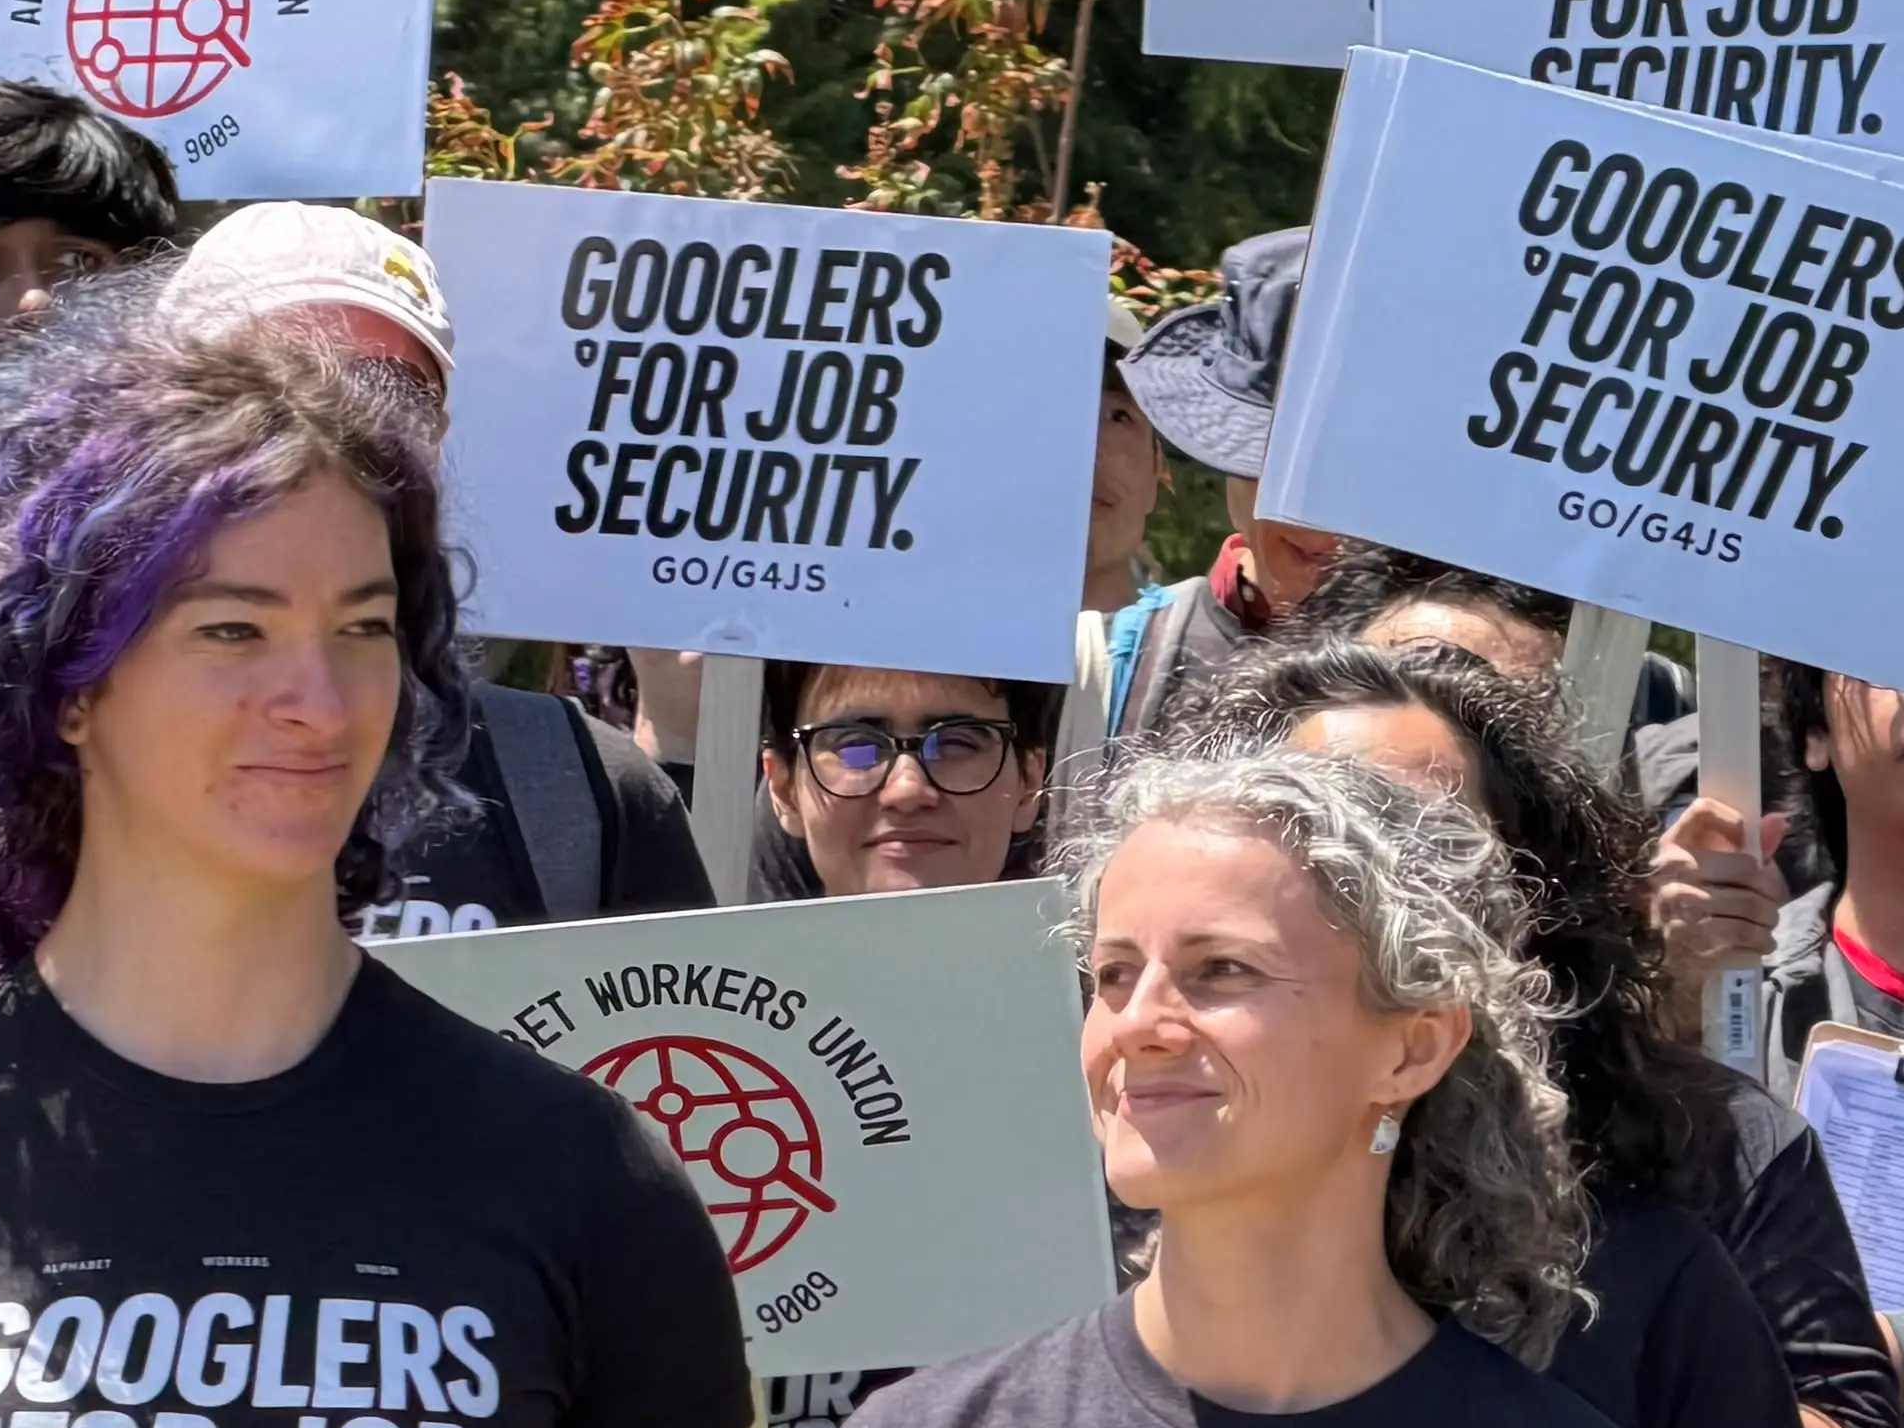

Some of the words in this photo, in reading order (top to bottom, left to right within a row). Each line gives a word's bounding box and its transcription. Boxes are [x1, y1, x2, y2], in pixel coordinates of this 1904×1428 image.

[183, 113, 242, 166] 9009
[561, 235, 951, 348] GOOGLERS
[1521, 255, 1694, 379] FOR
[1688, 301, 1870, 423] JOB
[587, 341, 739, 439] FOR
[745, 349, 905, 447] JOB
[1467, 351, 1869, 541] SECURITY.
[554, 439, 923, 552] SECURITY.
[1557, 490, 1743, 564] GO/G4JS
[652, 554, 827, 593] GO/G4JS
[586, 963, 808, 1031] WORKERS
[808, 1016, 911, 1147] UNION
[755, 1270, 840, 1334] 9009
